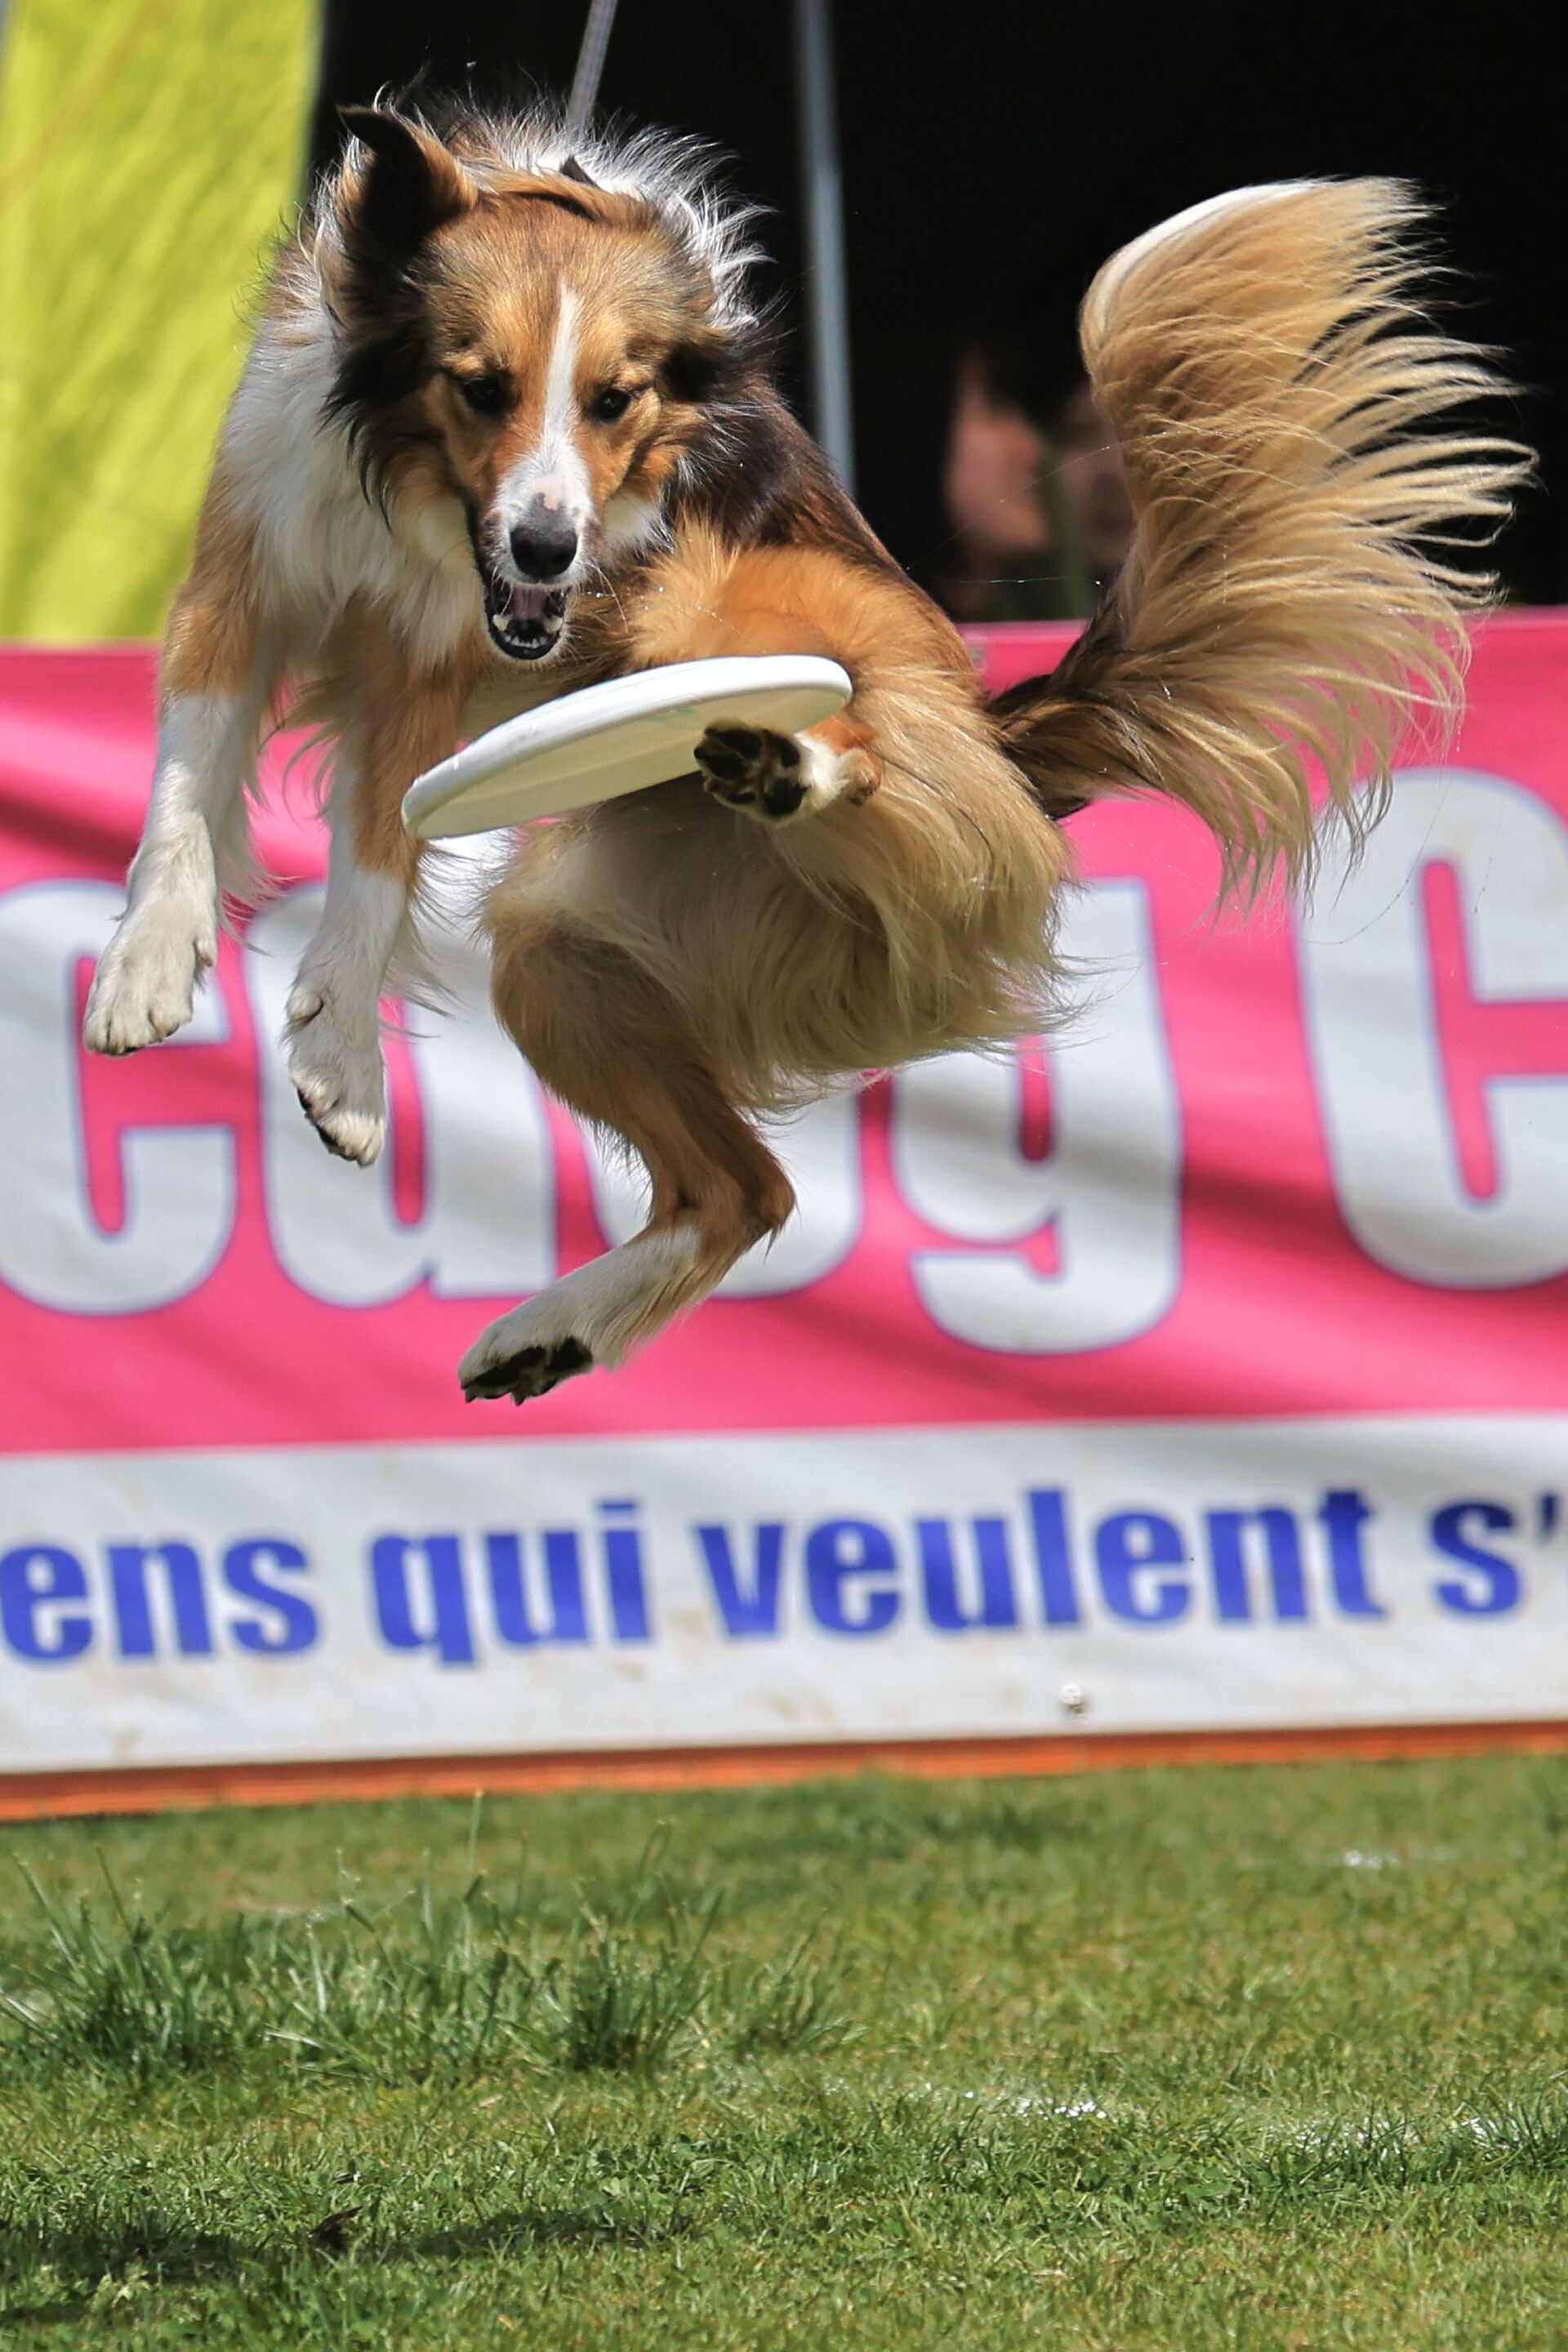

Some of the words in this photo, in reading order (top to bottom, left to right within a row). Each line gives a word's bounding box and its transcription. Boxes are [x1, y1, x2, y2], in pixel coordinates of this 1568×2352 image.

[0, 1542, 322, 1667] ens
[367, 1497, 652, 1668] qui
[691, 1486, 1384, 1641] veulent
